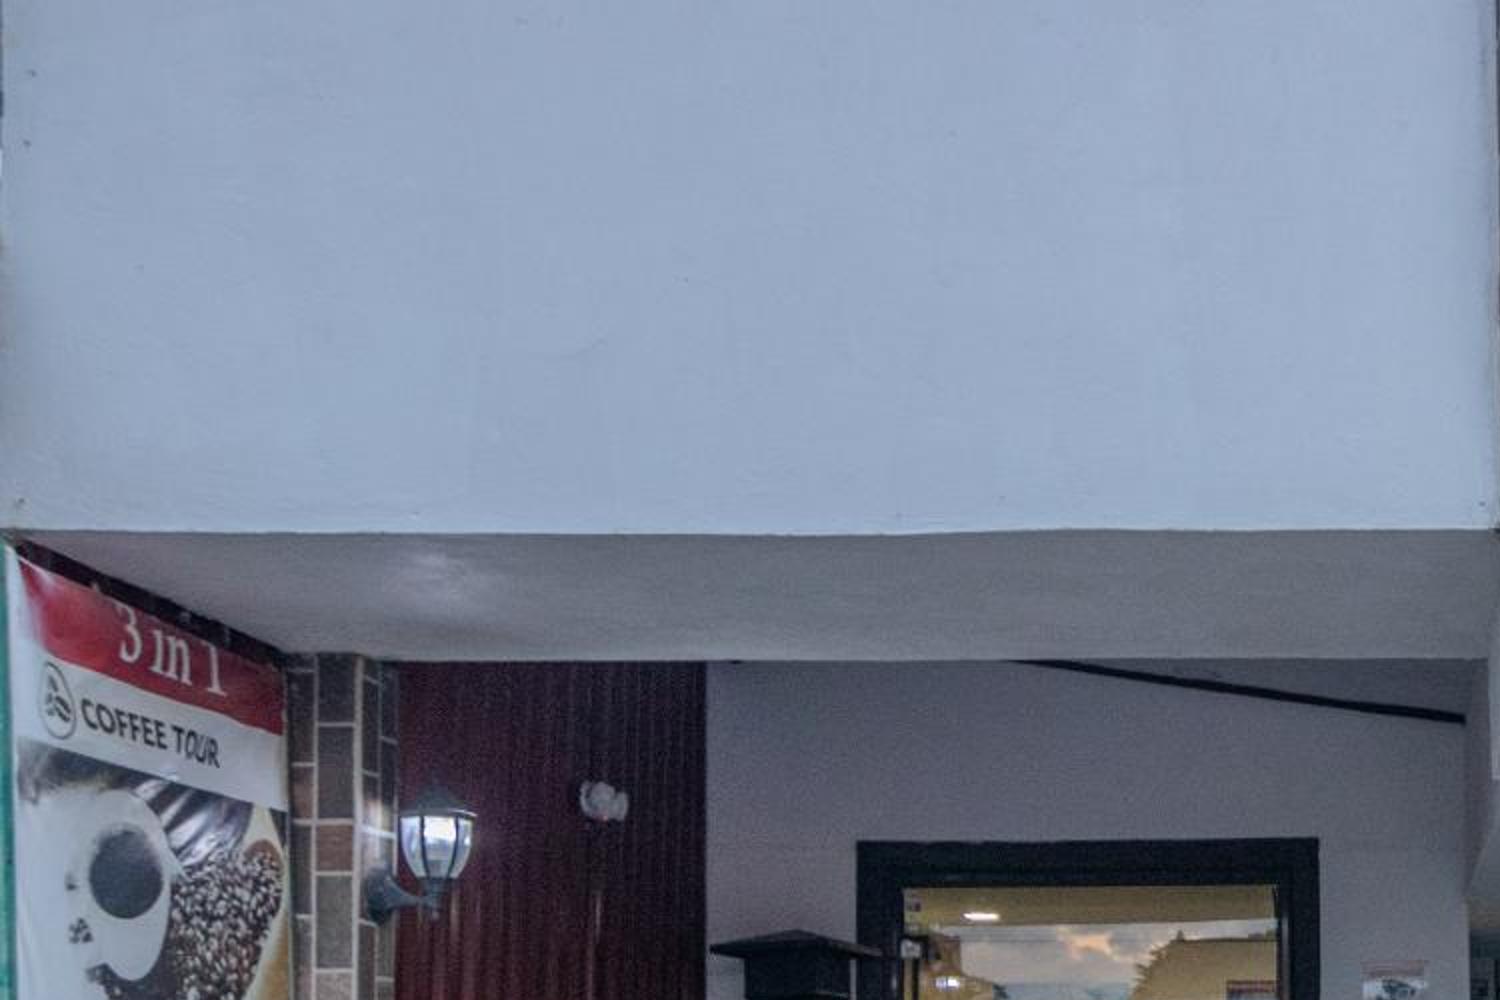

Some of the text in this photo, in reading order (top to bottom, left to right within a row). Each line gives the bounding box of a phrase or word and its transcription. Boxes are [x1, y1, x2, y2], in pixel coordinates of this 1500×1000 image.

[117, 604, 143, 664] 3
[81, 698, 221, 769] COFFEE TOUR
